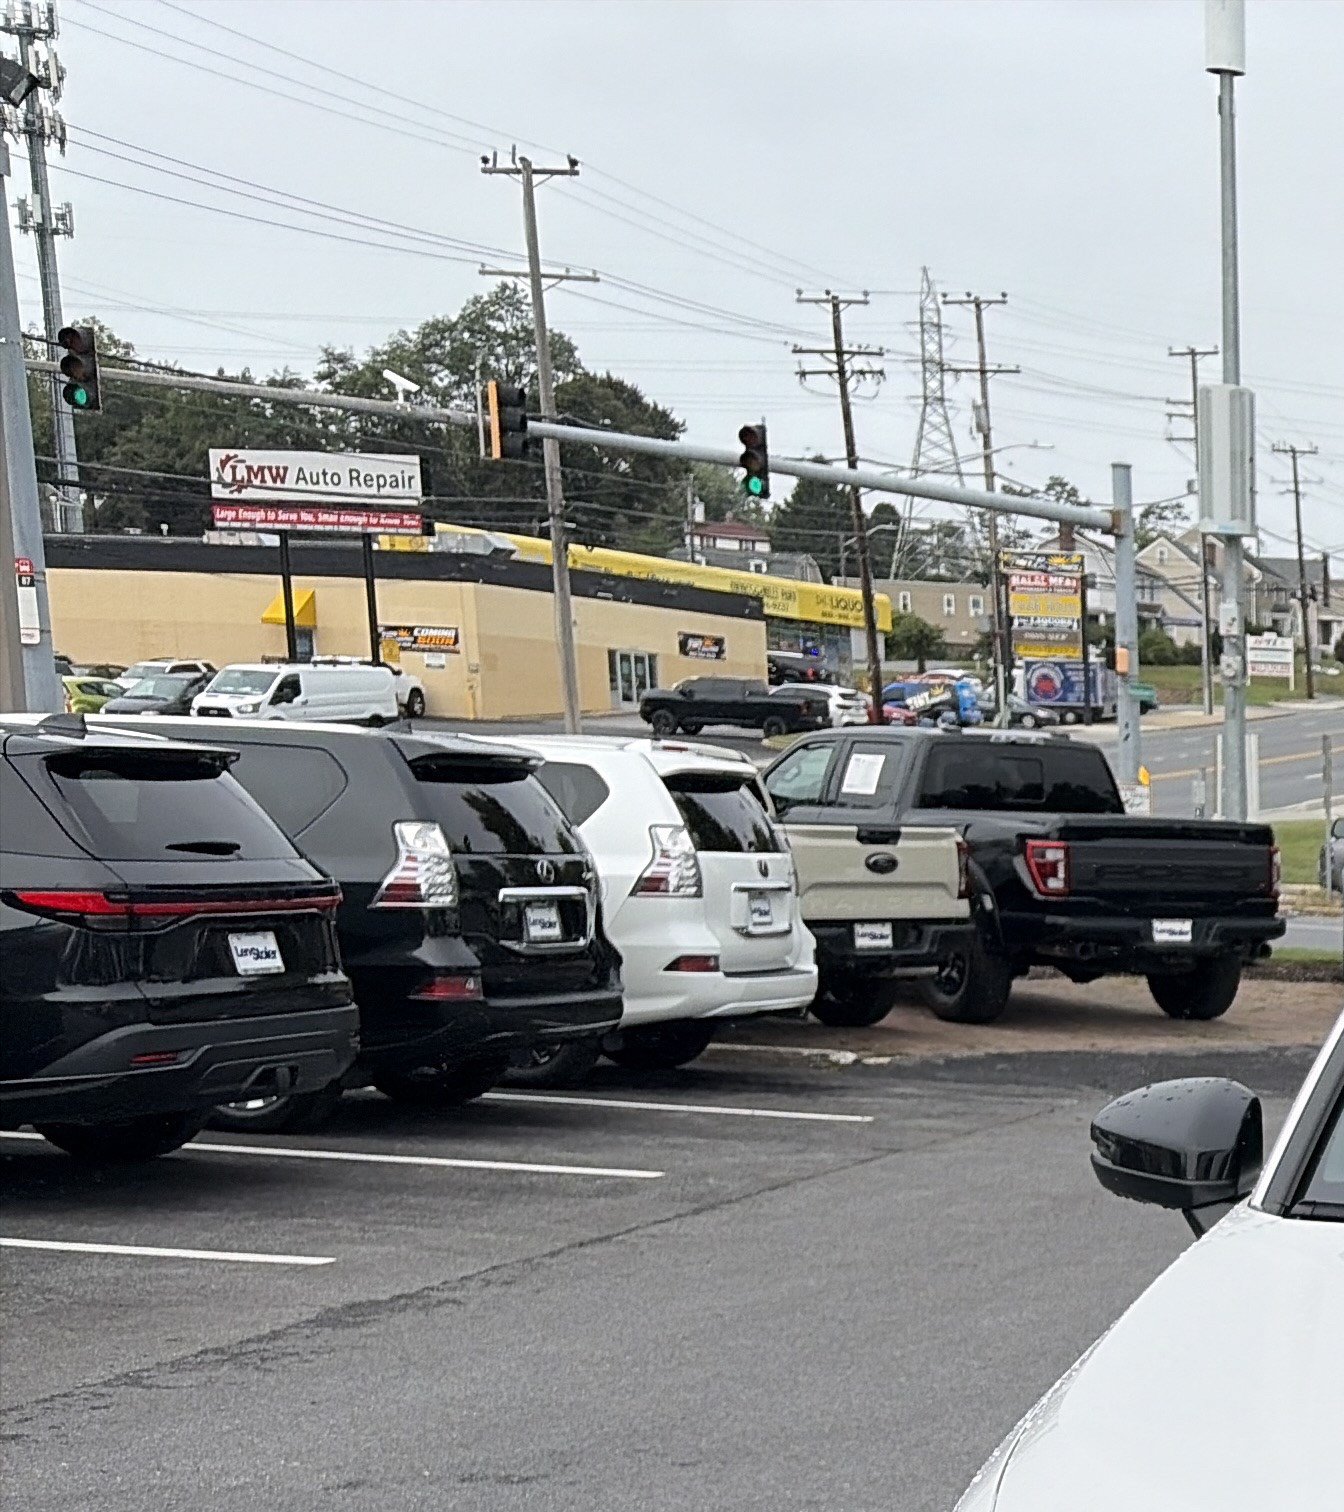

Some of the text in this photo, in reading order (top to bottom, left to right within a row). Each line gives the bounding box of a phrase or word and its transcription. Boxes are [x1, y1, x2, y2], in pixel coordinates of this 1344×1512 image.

[229, 464, 415, 493] LMW Auto Repair
[216, 507, 237, 521] Large
[238, 508, 266, 522] Enough
[267, 510, 276, 521] to
[277, 509, 298, 521] Serve
[830, 596, 864, 612] LIQUO
